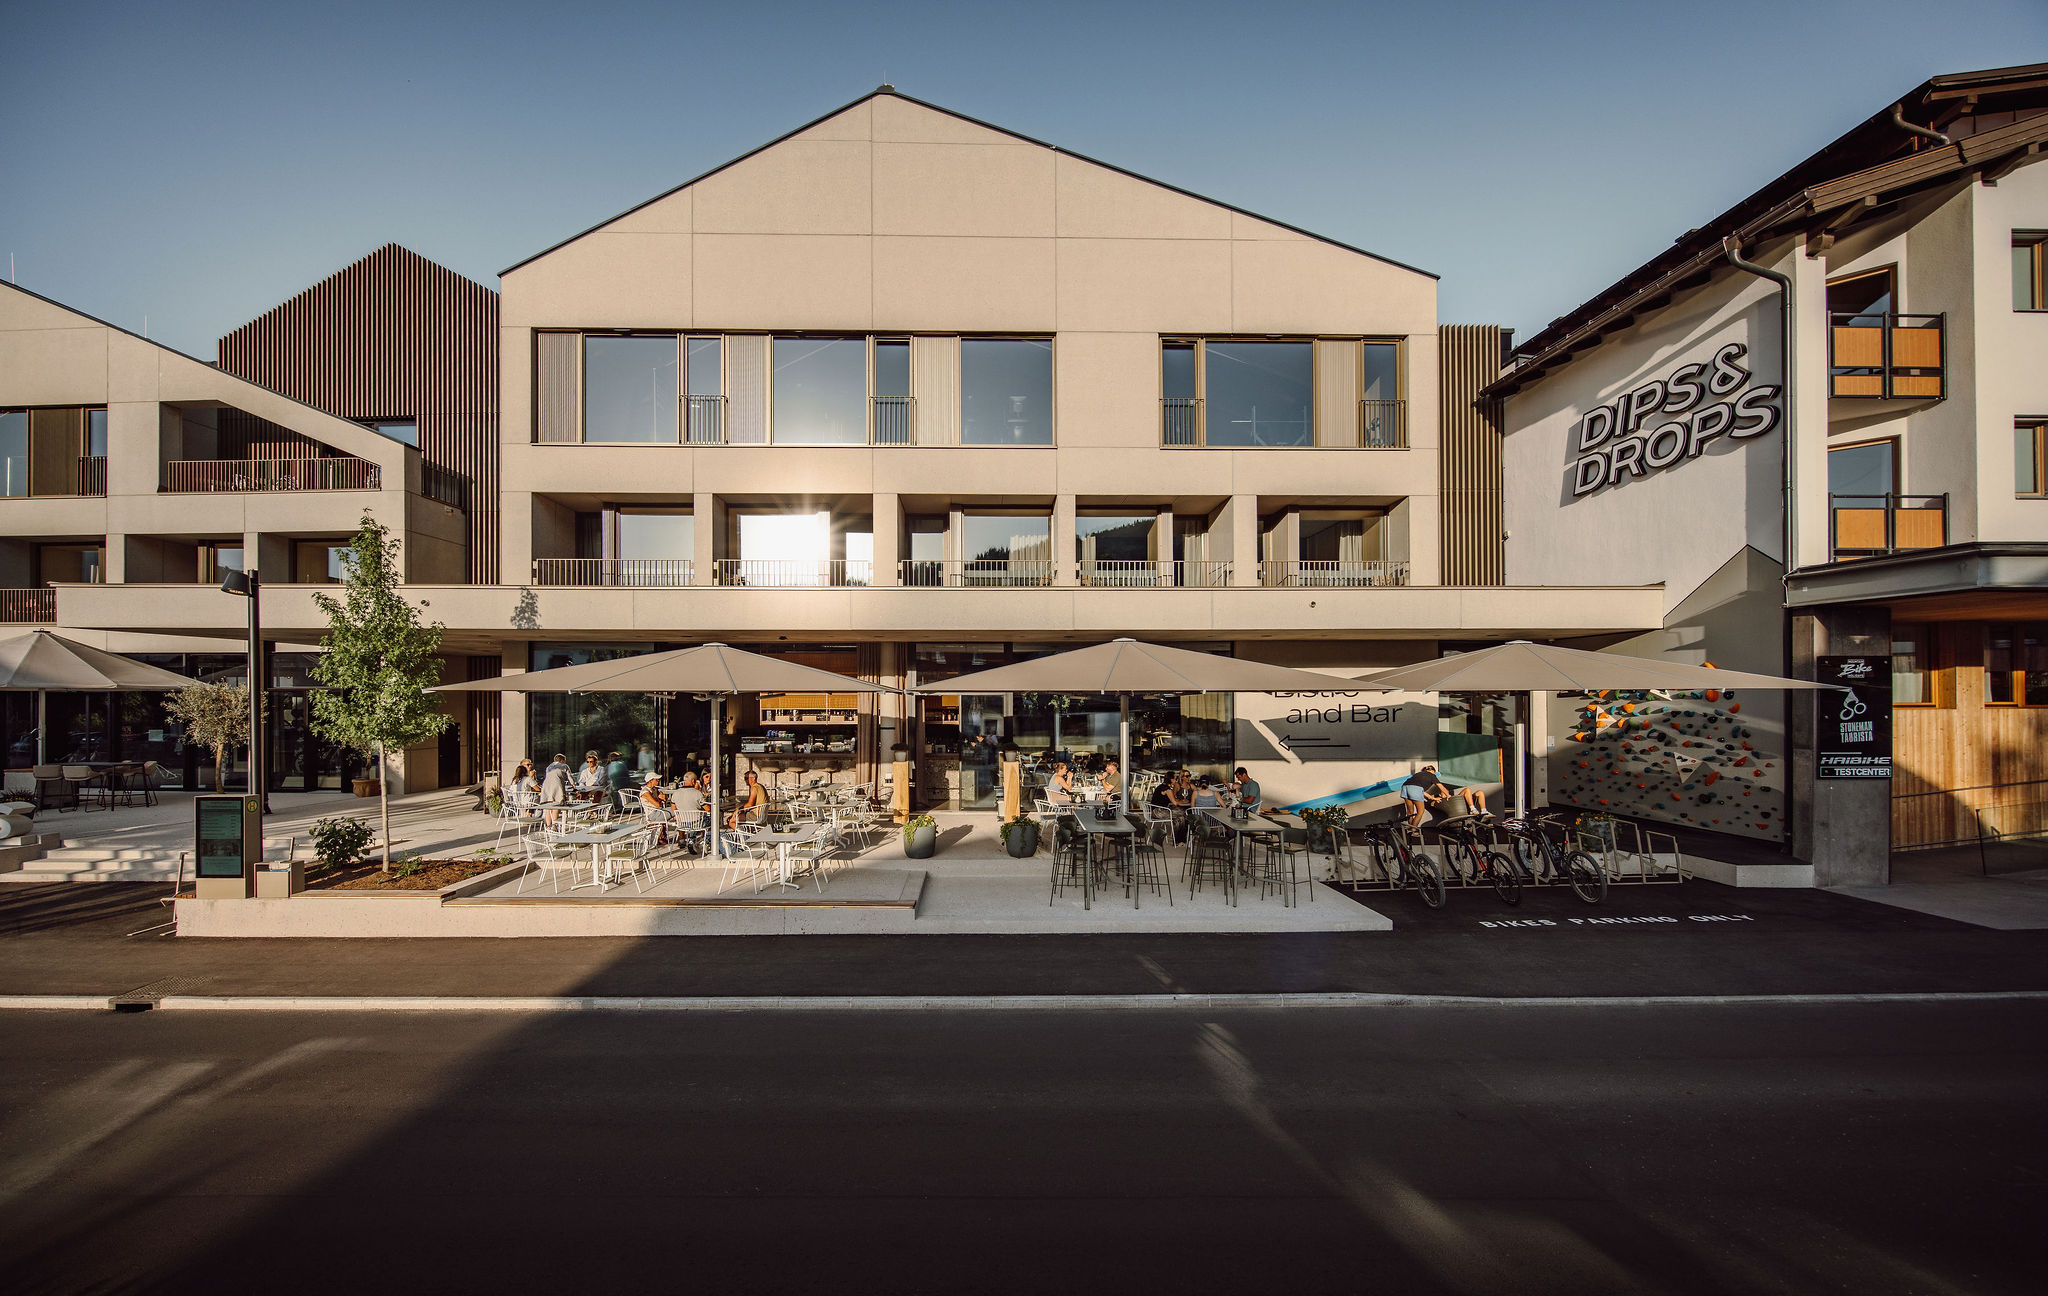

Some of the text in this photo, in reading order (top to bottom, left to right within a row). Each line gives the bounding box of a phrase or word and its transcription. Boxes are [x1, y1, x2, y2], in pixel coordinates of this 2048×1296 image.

[1578, 342, 1753, 453] DIPS &
[1573, 384, 1783, 497] DROPS
[1840, 663, 1873, 676] Bike
[1286, 703, 1403, 724] and Bar
[1840, 721, 1873, 733] STONEMAN
[1840, 731, 1874, 743] TAURISTA
[1834, 768, 1890, 776] TESTCENTER
[1478, 919, 1558, 928] BIKES
[1567, 916, 1679, 925] PARKING
